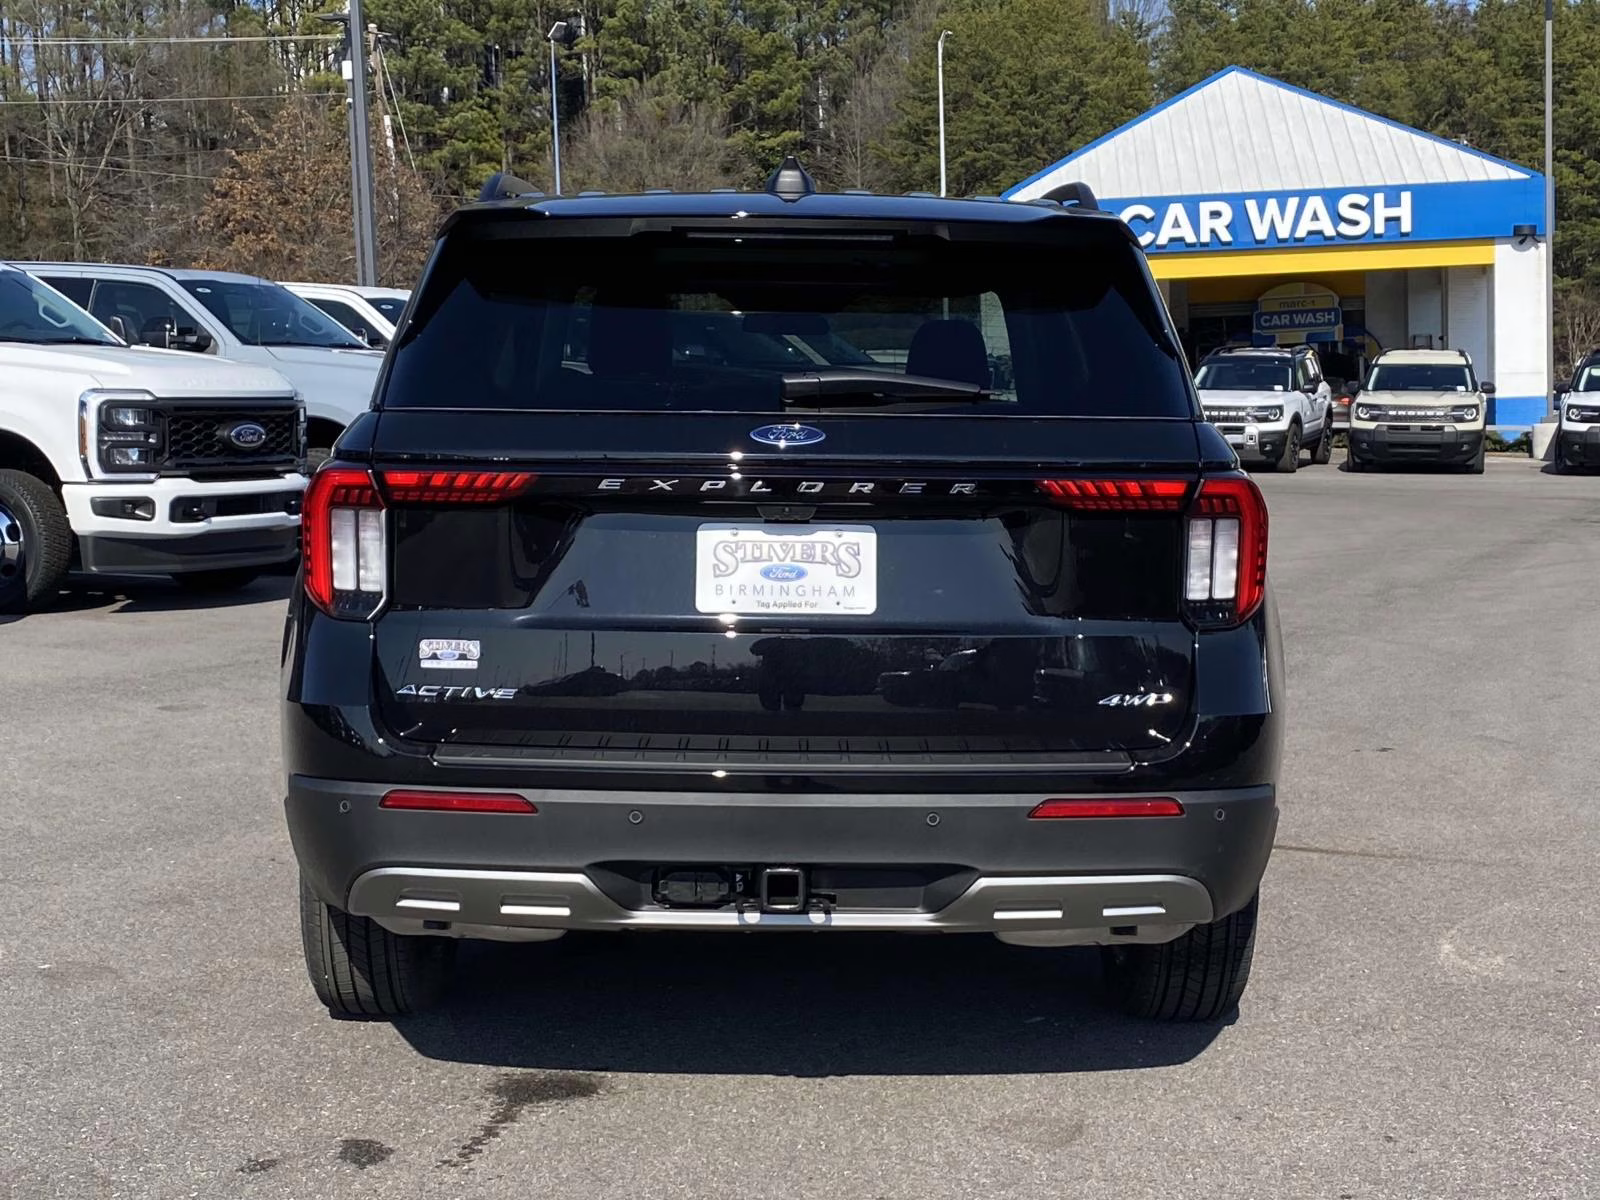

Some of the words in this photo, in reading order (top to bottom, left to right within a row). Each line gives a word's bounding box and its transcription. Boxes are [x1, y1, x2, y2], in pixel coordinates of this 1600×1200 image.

[1119, 201, 1233, 247] CAR
[1244, 191, 1412, 241] WASH
[1260, 314, 1290, 327] CAR
[1293, 311, 1335, 325] WASH
[597, 478, 978, 495] EXPLORER
[712, 540, 862, 578] STIVERS
[714, 583, 856, 598] BIRMINGHAM
[756, 600, 770, 609] Tag
[772, 600, 803, 610] Applied
[804, 601, 818, 609] For
[396, 684, 519, 701] ACTIVE
[1098, 692, 1173, 706] 4WD
